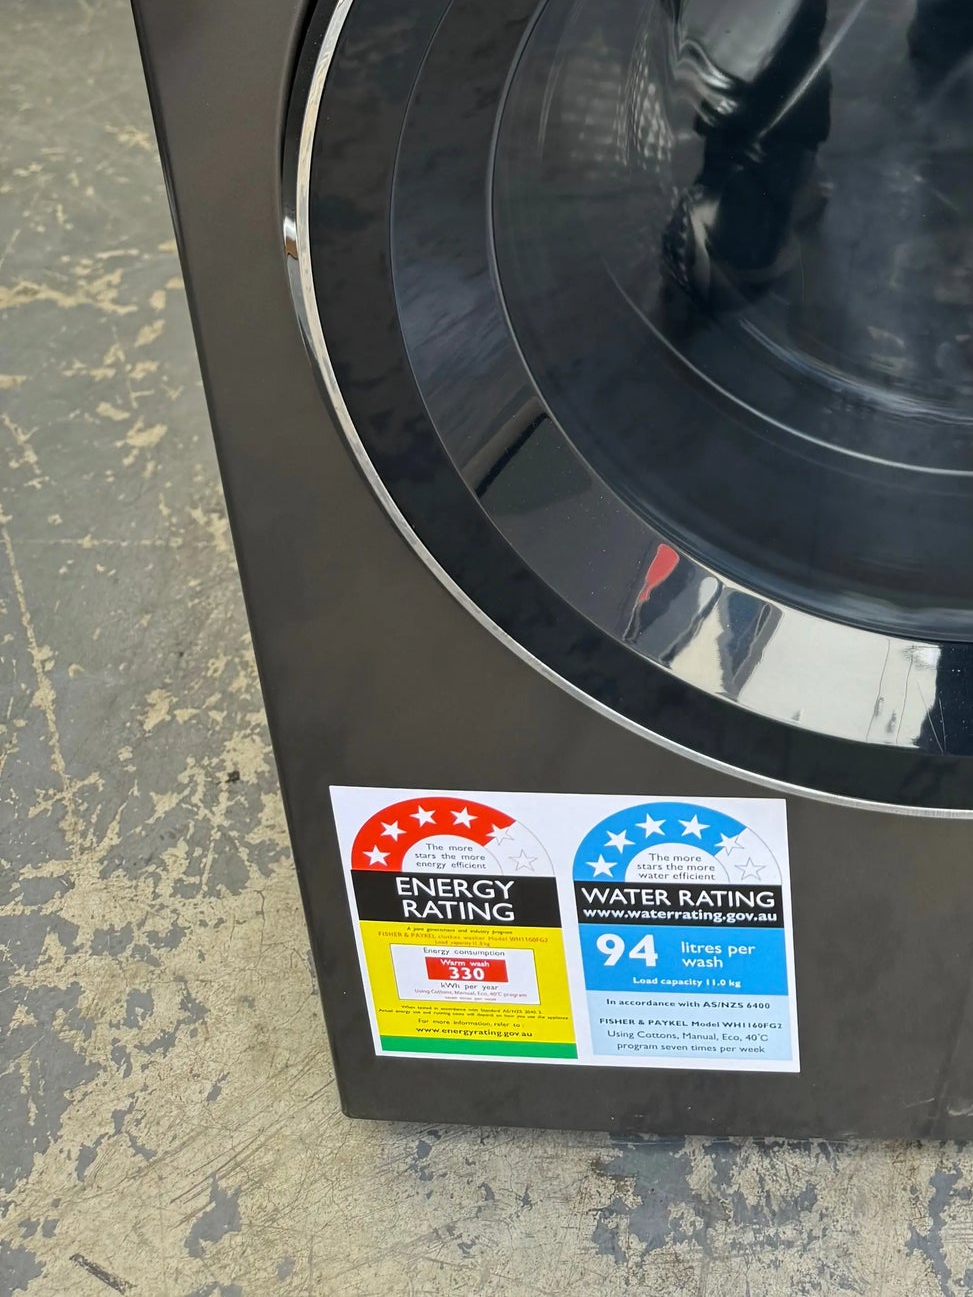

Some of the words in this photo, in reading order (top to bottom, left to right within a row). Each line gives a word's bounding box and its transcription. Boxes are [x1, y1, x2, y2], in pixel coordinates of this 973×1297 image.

[426, 843, 444, 851] The
[649, 853, 670, 862] The
[416, 861, 447, 869] energy
[451, 861, 487, 870] efficient
[637, 863, 662, 871] stars
[666, 863, 683, 871] the
[687, 864, 715, 872] more
[639, 872, 669, 880] water
[673, 872, 716, 881] efficient
[395, 876, 515, 900] ENERGY
[581, 887, 671, 906] WATER
[679, 890, 775, 908] RATING
[402, 900, 515, 922] RATING
[583, 908, 777, 923] www.waterrating.gov.au
[423, 947, 450, 955] Energy
[454, 949, 505, 957] consumption
[596, 933, 658, 967] 94
[681, 941, 722, 954] litres
[728, 945, 755, 957] per
[682, 956, 723, 968] wash
[448, 967, 485, 981] 330
[633, 976, 658, 985] Load
[660, 977, 702, 987] capacity
[706, 978, 726, 986] 11.0
[728, 979, 741, 988] kg
[619, 999, 675, 1007] accordance
[648, 1019, 688, 1027] PAYKEL
[722, 1021, 782, 1029] WH1160FG2
[607, 1030, 634, 1039] Using
[637, 1031, 679, 1040] Cottons,
[682, 1032, 719, 1041] Manual,
[722, 1033, 742, 1042] Eco,
[617, 1043, 658, 1051] program
